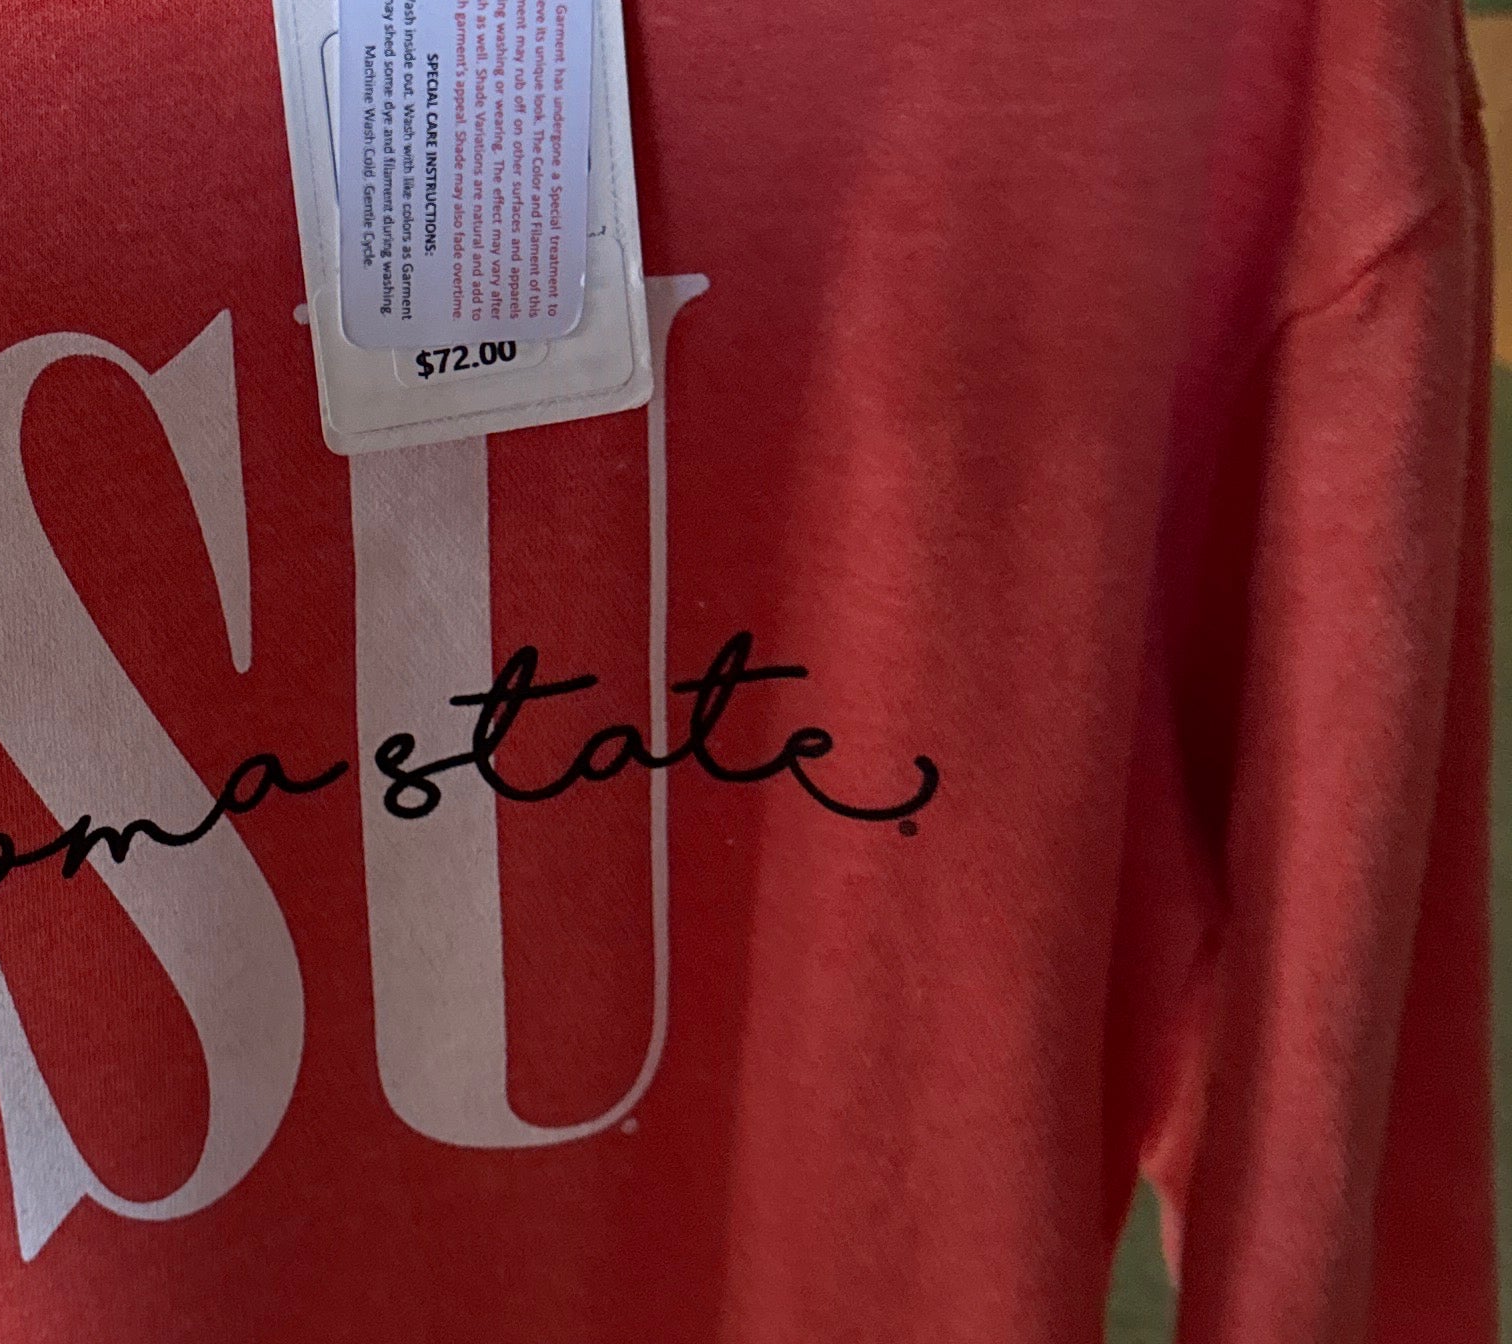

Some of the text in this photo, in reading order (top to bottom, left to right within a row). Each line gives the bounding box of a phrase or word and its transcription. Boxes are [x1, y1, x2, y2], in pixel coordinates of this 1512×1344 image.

[477, 16, 486, 29] as
[536, 28, 547, 42] its
[554, 5, 567, 62] Garment
[384, 24, 396, 56] shed
[404, 29, 416, 69] inside
[493, 23, 507, 76] washing
[513, 35, 525, 62] may
[365, 46, 376, 103] Machine
[384, 61, 394, 97] some
[515, 69, 526, 90] rub
[533, 46, 546, 91] unique
[554, 69, 565, 91] has
[475, 69, 487, 107] Shade
[496, 81, 505, 94] or
[382, 102, 395, 126] dye
[515, 96, 526, 113] off
[364, 108, 376, 144] Wash
[404, 104, 415, 141] Wash
[514, 119, 524, 135] on
[550, 97, 564, 166] undergone
[384, 130, 395, 153] and
[425, 54, 439, 256] SPECIAL CARE INSTRUCTIONS:
[454, 131, 466, 169] Shade
[474, 112, 486, 175] Variations
[533, 130, 544, 153] The
[404, 144, 414, 173] with
[493, 160, 504, 183] The
[513, 141, 524, 175] other
[384, 158, 394, 212] filament
[452, 174, 463, 199] may
[532, 158, 544, 190] Color
[474, 180, 483, 200] are
[364, 186, 375, 228] Gentle
[454, 204, 464, 228] also
[492, 188, 504, 223] effect
[512, 182, 524, 232] surfaces
[531, 195, 542, 218] and
[549, 186, 563, 230] Special
[380, 216, 394, 258] during
[402, 204, 414, 242] colors
[473, 205, 484, 248] natural
[402, 246, 411, 259] as
[453, 232, 465, 258] fade
[490, 229, 501, 254] may
[511, 238, 522, 261] and
[530, 223, 542, 275] Filament
[472, 254, 483, 276] and
[490, 260, 500, 286] vary
[549, 236, 560, 298] treatment
[402, 264, 414, 320] Garment
[472, 281, 483, 303] add
[508, 267, 522, 319] apparels
[529, 280, 541, 292] of
[472, 308, 482, 321] to
[491, 291, 502, 319] after
[529, 296, 541, 318] this
[548, 304, 559, 317] to
[415, 340, 517, 379] $72.00
